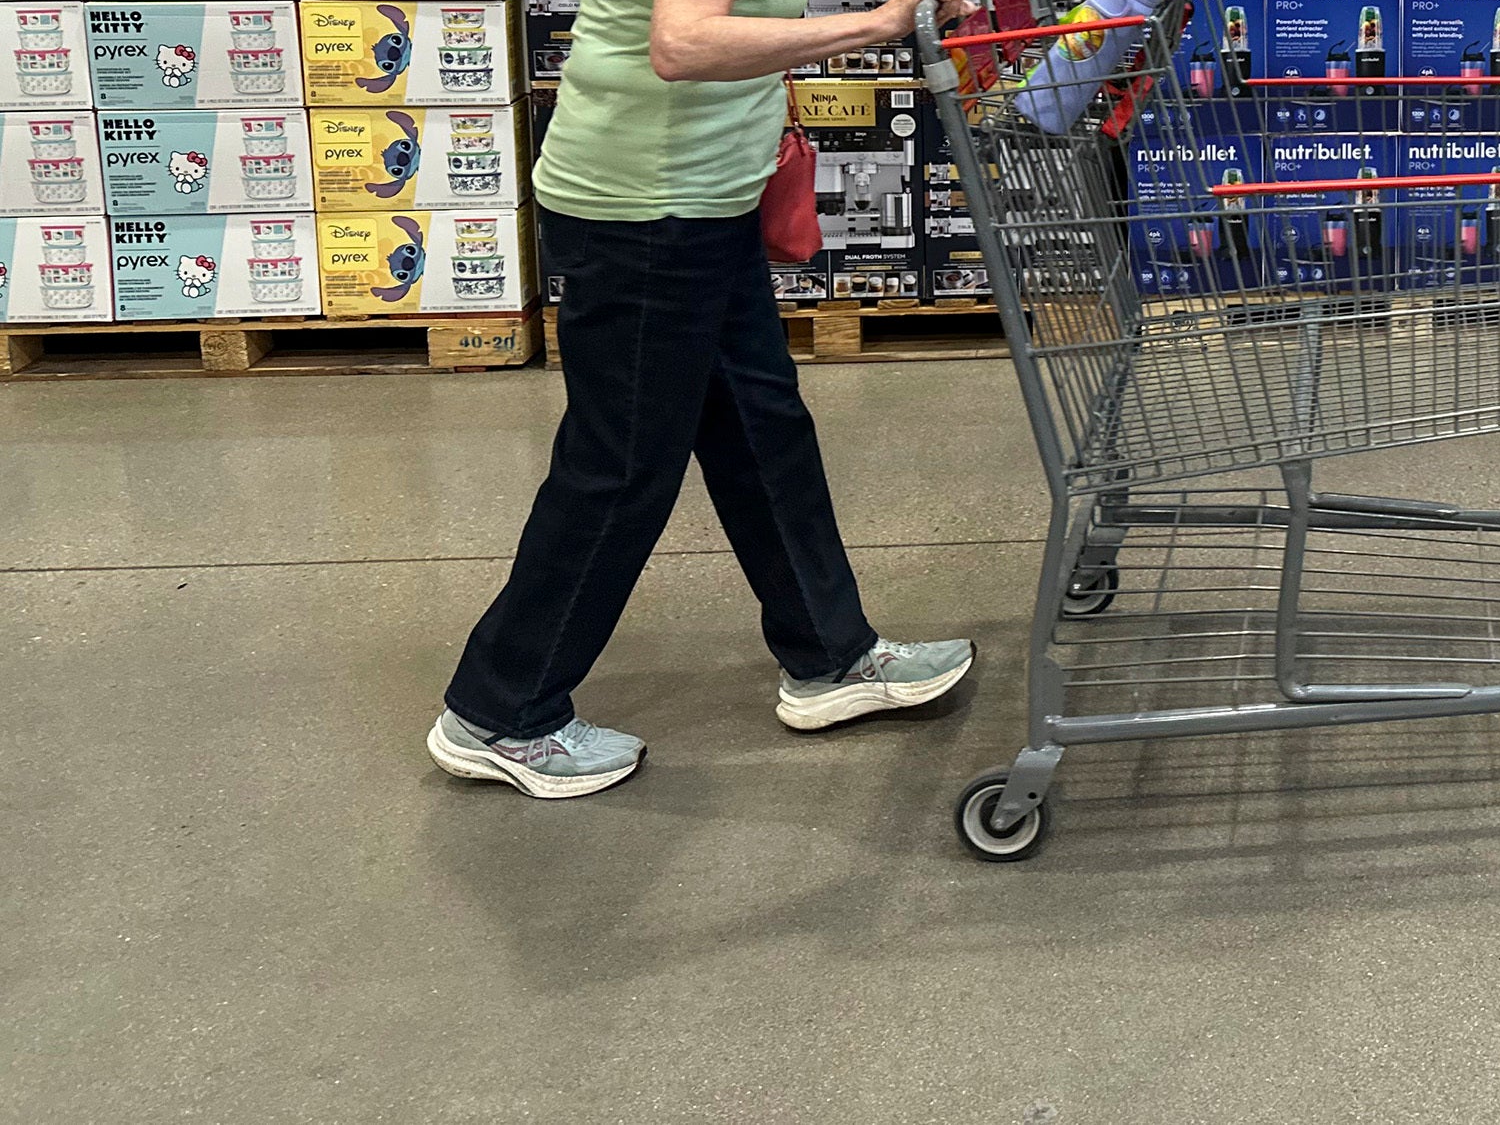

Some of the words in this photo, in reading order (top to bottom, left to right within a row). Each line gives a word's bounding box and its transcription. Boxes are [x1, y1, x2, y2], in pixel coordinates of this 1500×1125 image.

[90, 11, 142, 22] HELLO
[90, 22, 144, 34] KITTY
[93, 43, 148, 61] pyrex
[315, 41, 353, 55] pyrex
